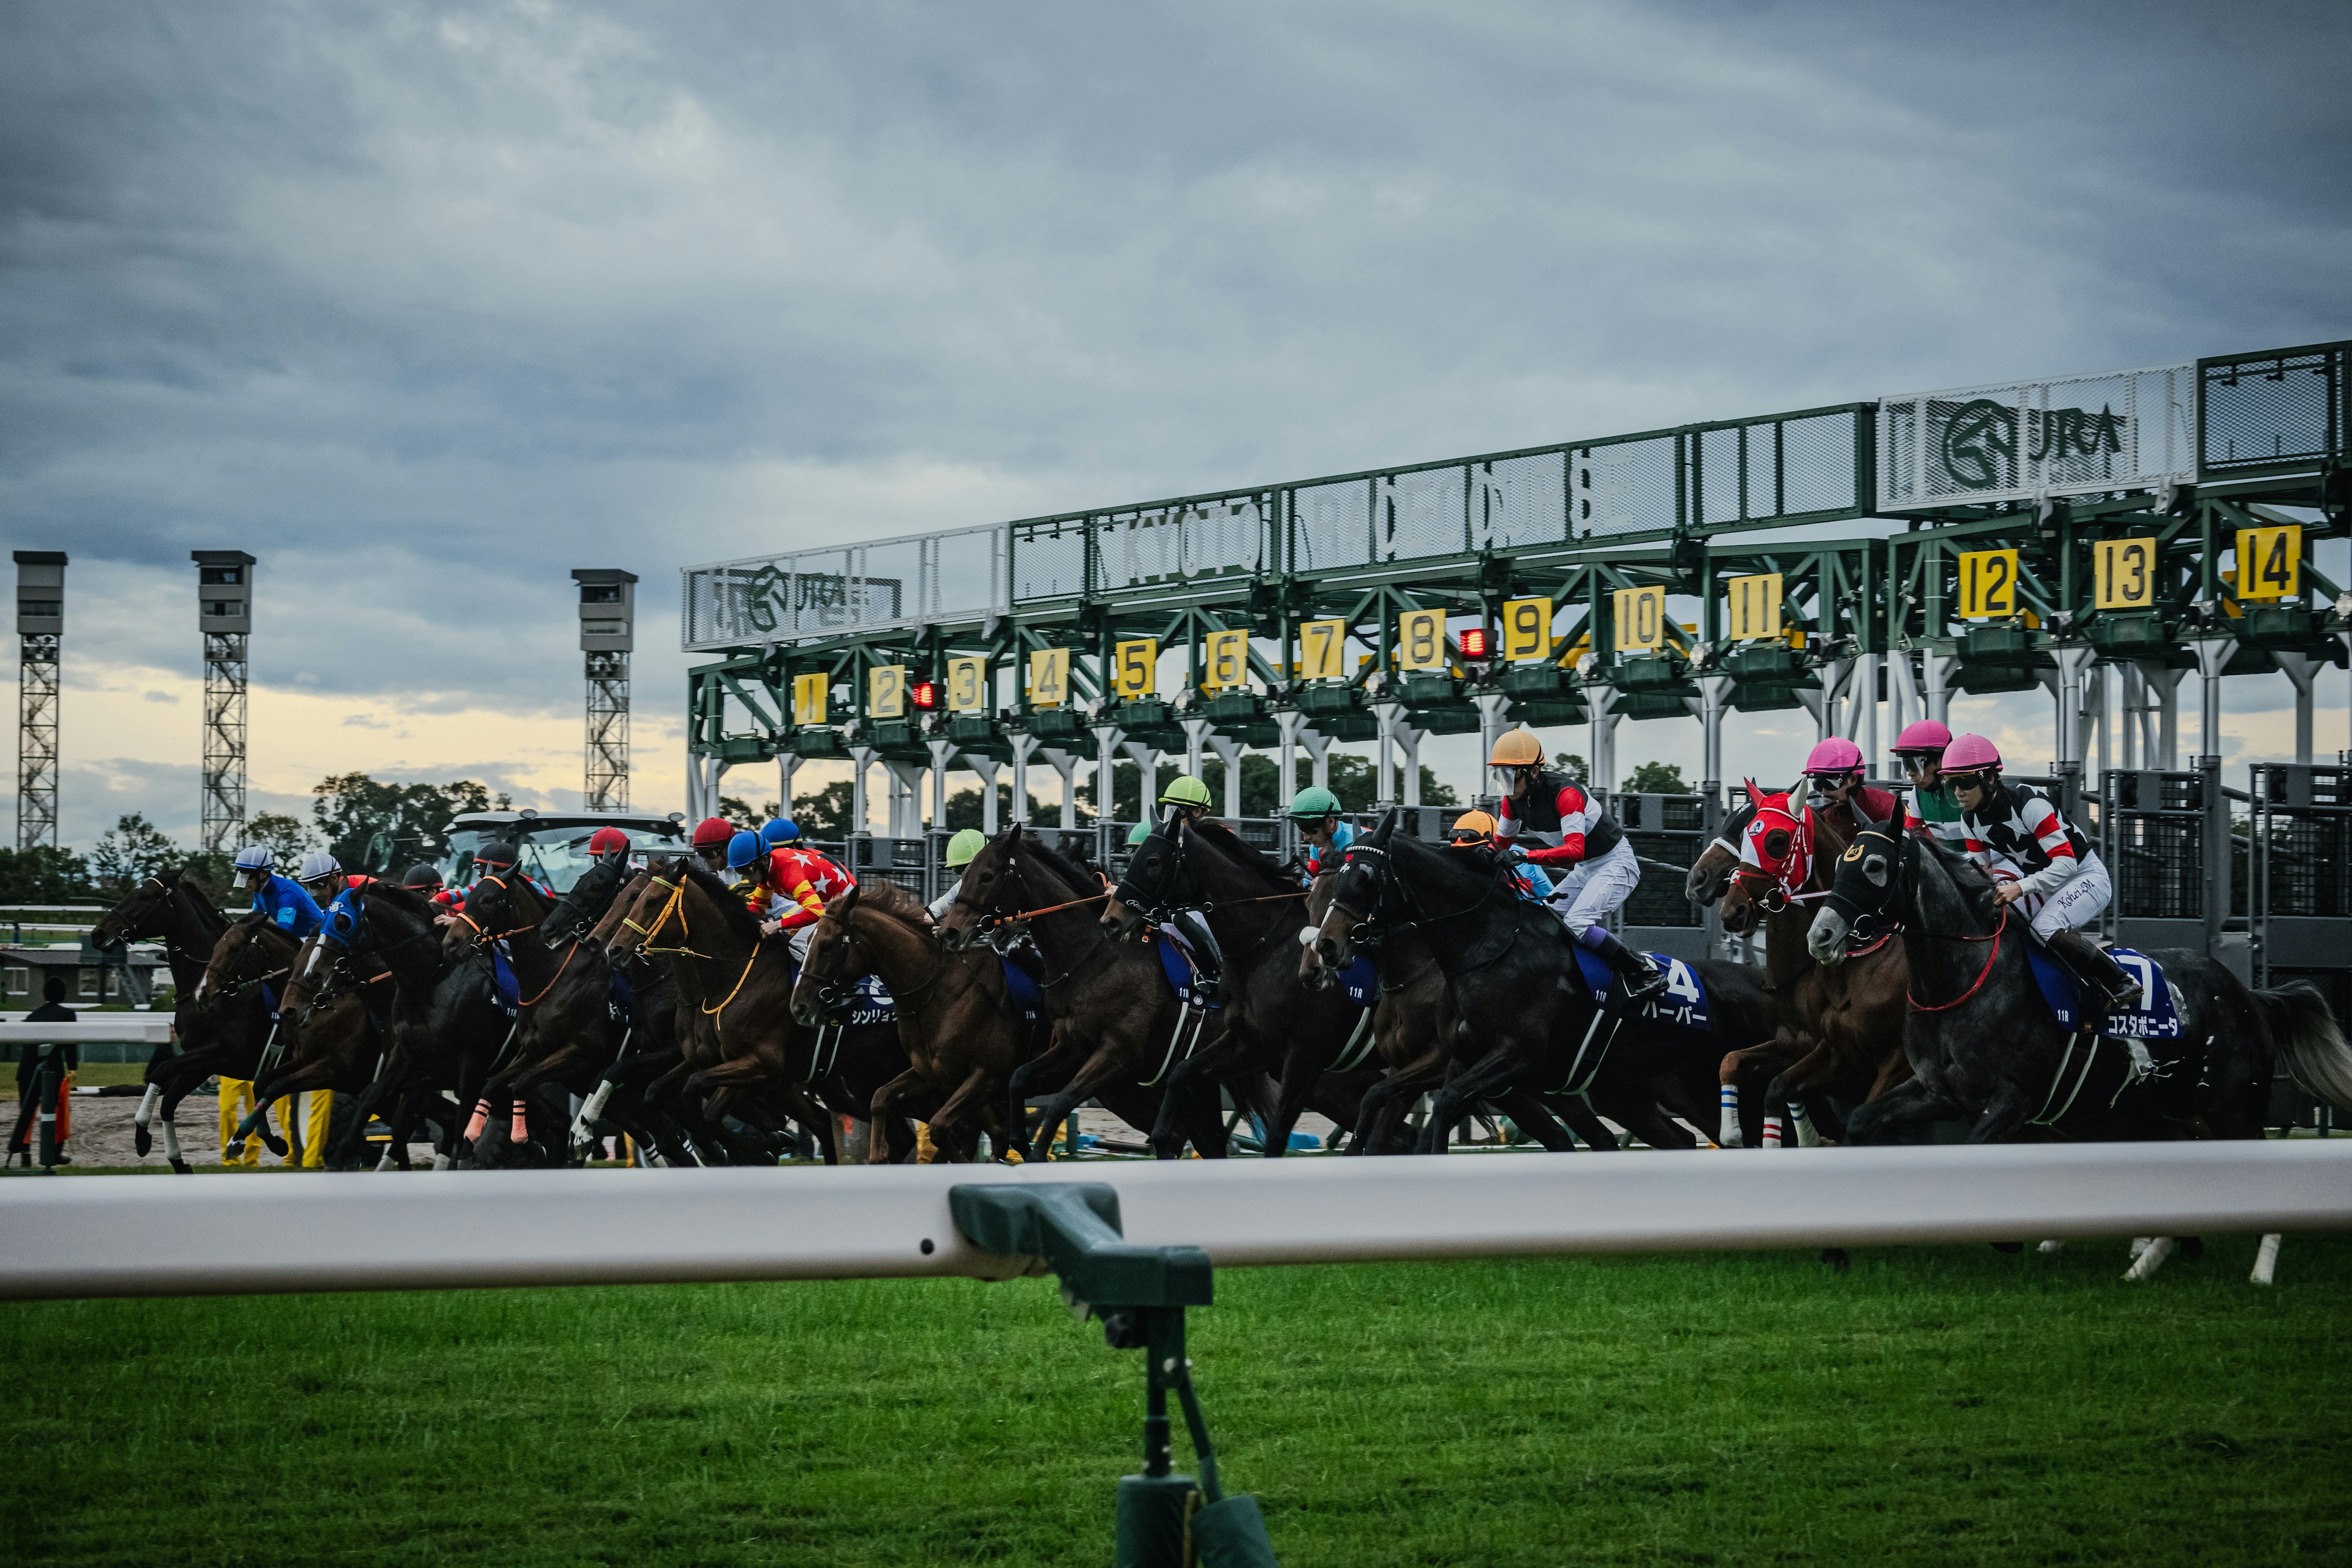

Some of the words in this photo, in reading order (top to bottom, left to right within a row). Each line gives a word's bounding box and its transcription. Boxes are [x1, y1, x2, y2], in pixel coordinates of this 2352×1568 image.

[2029, 404, 2122, 461] JRA
[1123, 502, 1262, 586] KYOTO
[2248, 532, 2291, 593] 14
[1969, 556, 2008, 612] 12
[2106, 544, 2146, 602] 13
[1624, 592, 1656, 644] 10
[1742, 579, 1768, 633] 11
[1311, 625, 1333, 674] 7
[1411, 616, 1434, 664] 8
[1515, 605, 1540, 655] 9
[1038, 654, 1059, 699] 4
[1125, 644, 1147, 691] 5
[1216, 635, 1238, 682] 6
[877, 670, 897, 713] 2
[956, 663, 976, 705] 3
[2057, 886, 2082, 909] Kohei
[1026, 1009, 1036, 1019] 11R
[1180, 987, 1189, 999] 11R
[1349, 986, 1363, 998] 11R
[1596, 989, 1607, 1003] 11R
[1642, 1000, 1707, 1025] ハーパー
[2057, 1009, 2069, 1022] 11R
